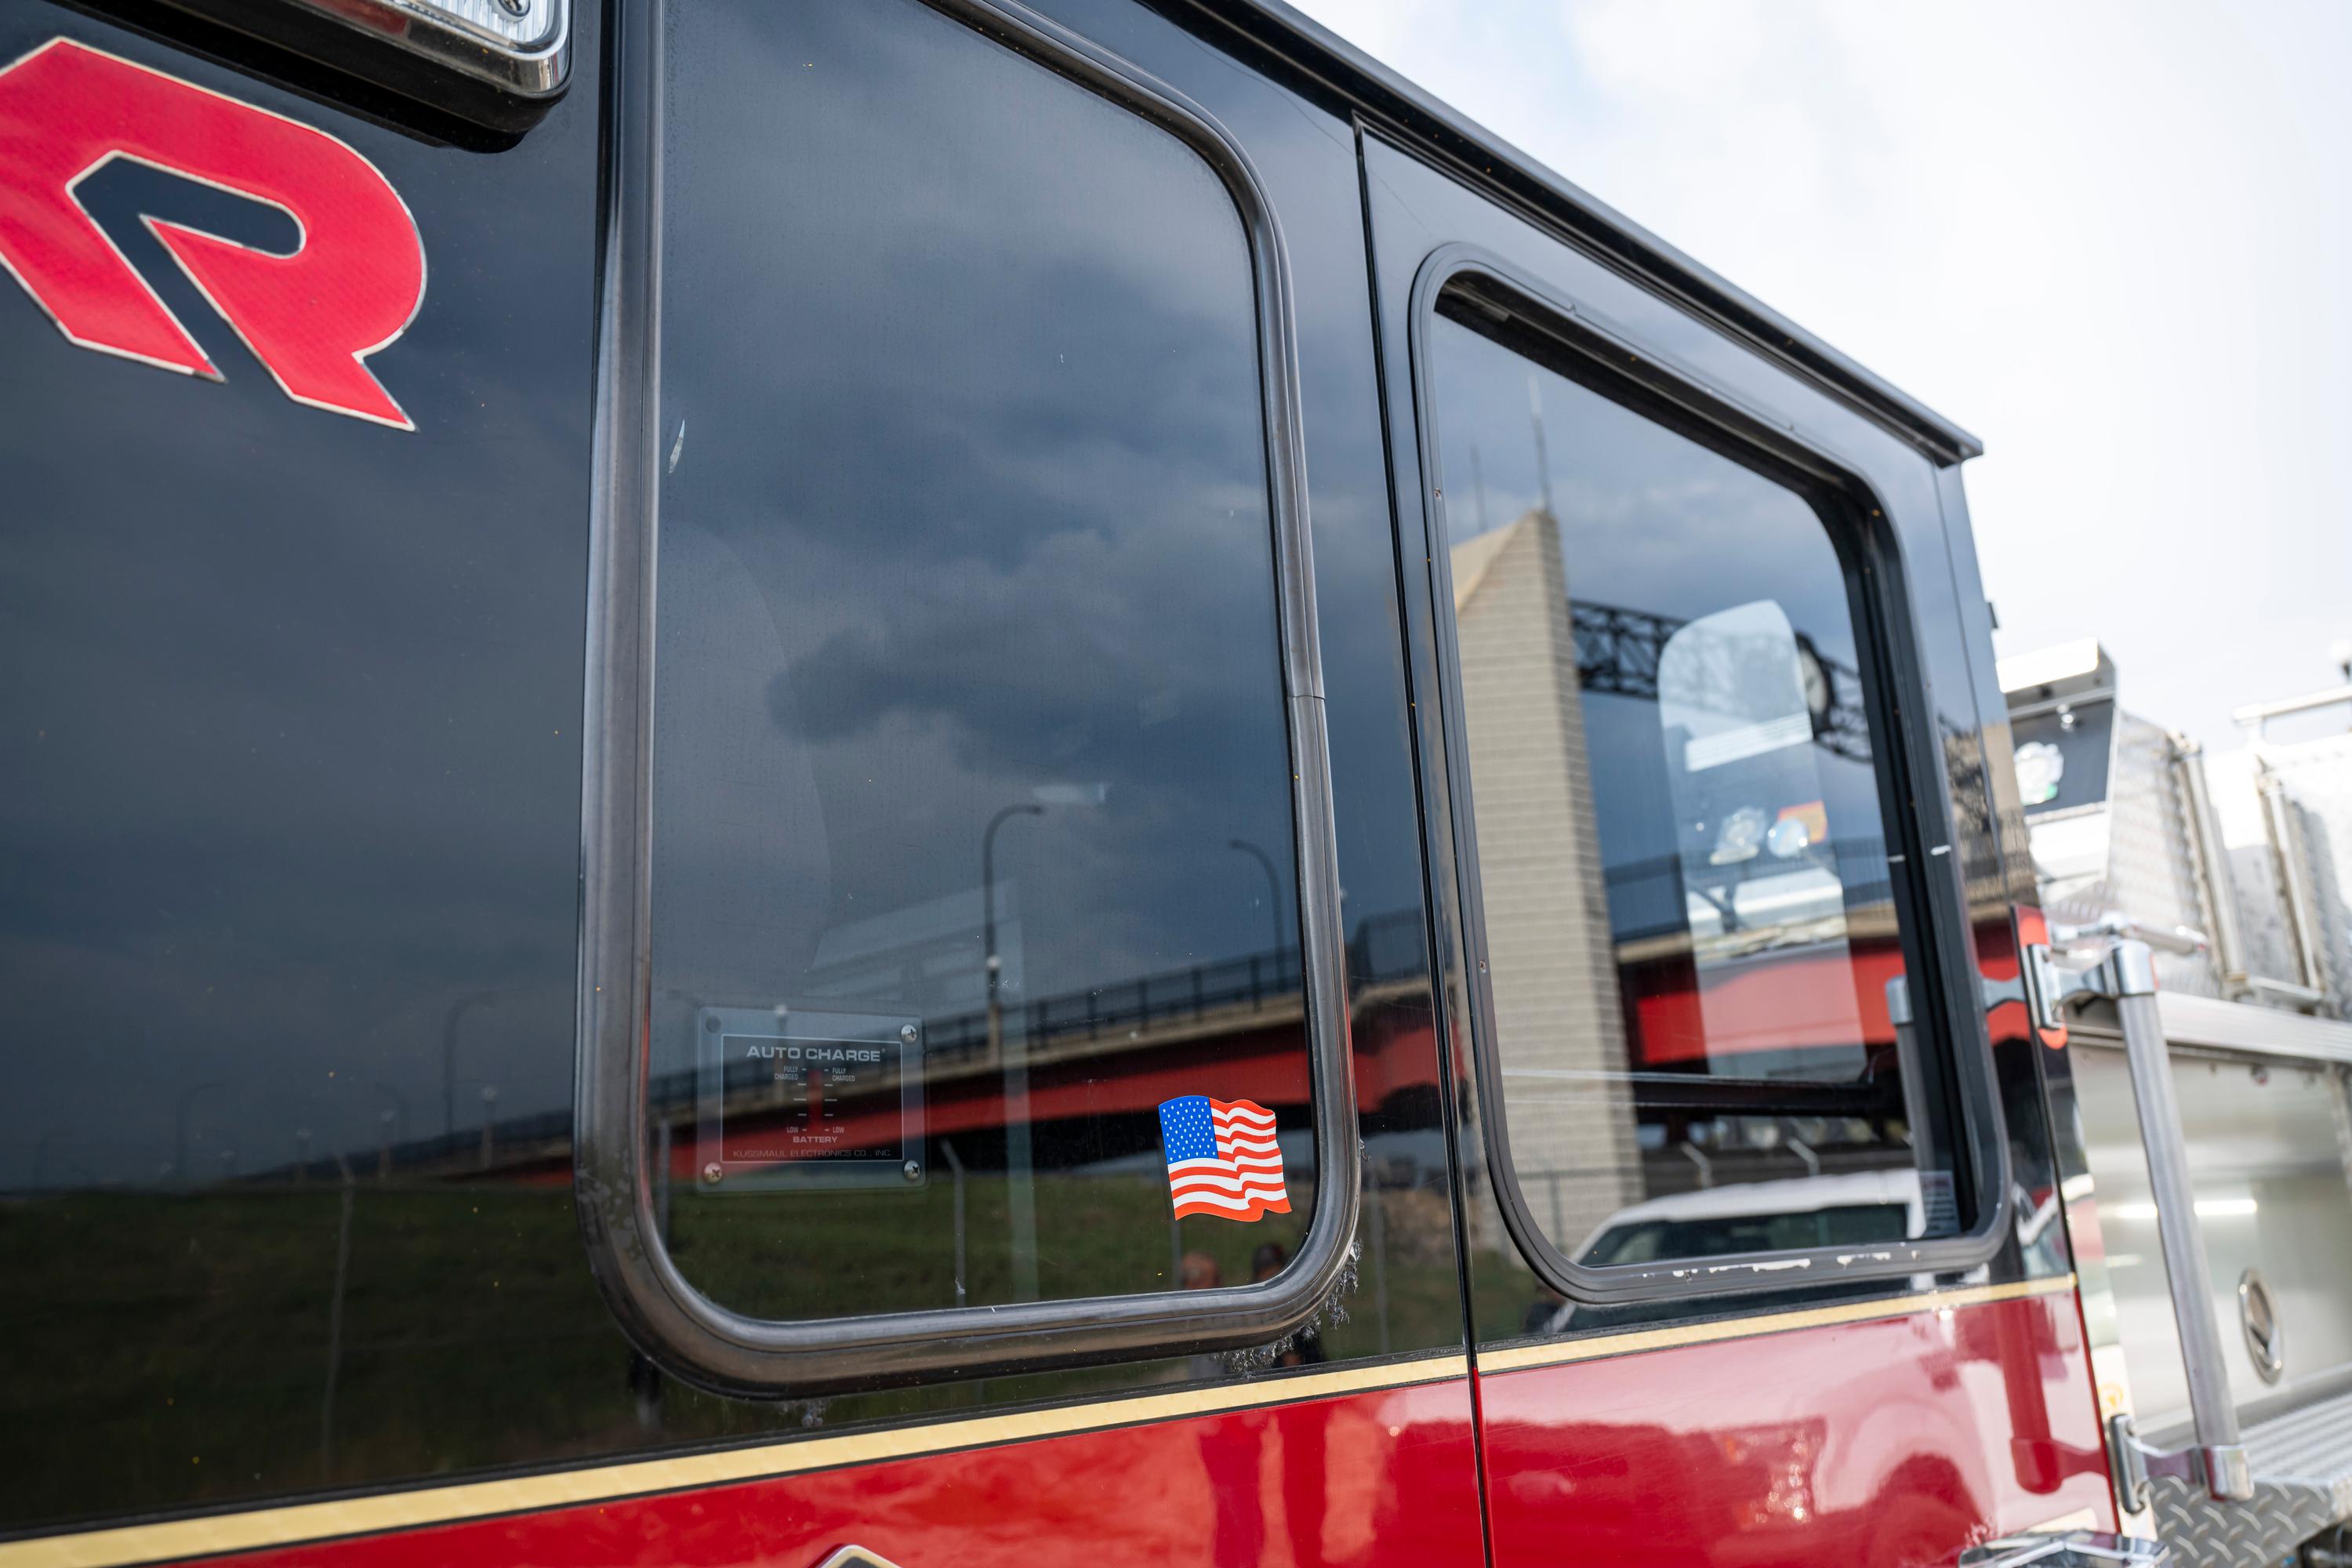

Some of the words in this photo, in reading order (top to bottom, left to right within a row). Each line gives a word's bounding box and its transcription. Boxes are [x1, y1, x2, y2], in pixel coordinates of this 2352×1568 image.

[746, 1045, 801, 1059] AUTO
[805, 1047, 881, 1062] CHARGE
[774, 1073, 799, 1081] CHARGED
[832, 1074, 856, 1083] CHARGED
[790, 1149, 851, 1157] ELECTRONICS
